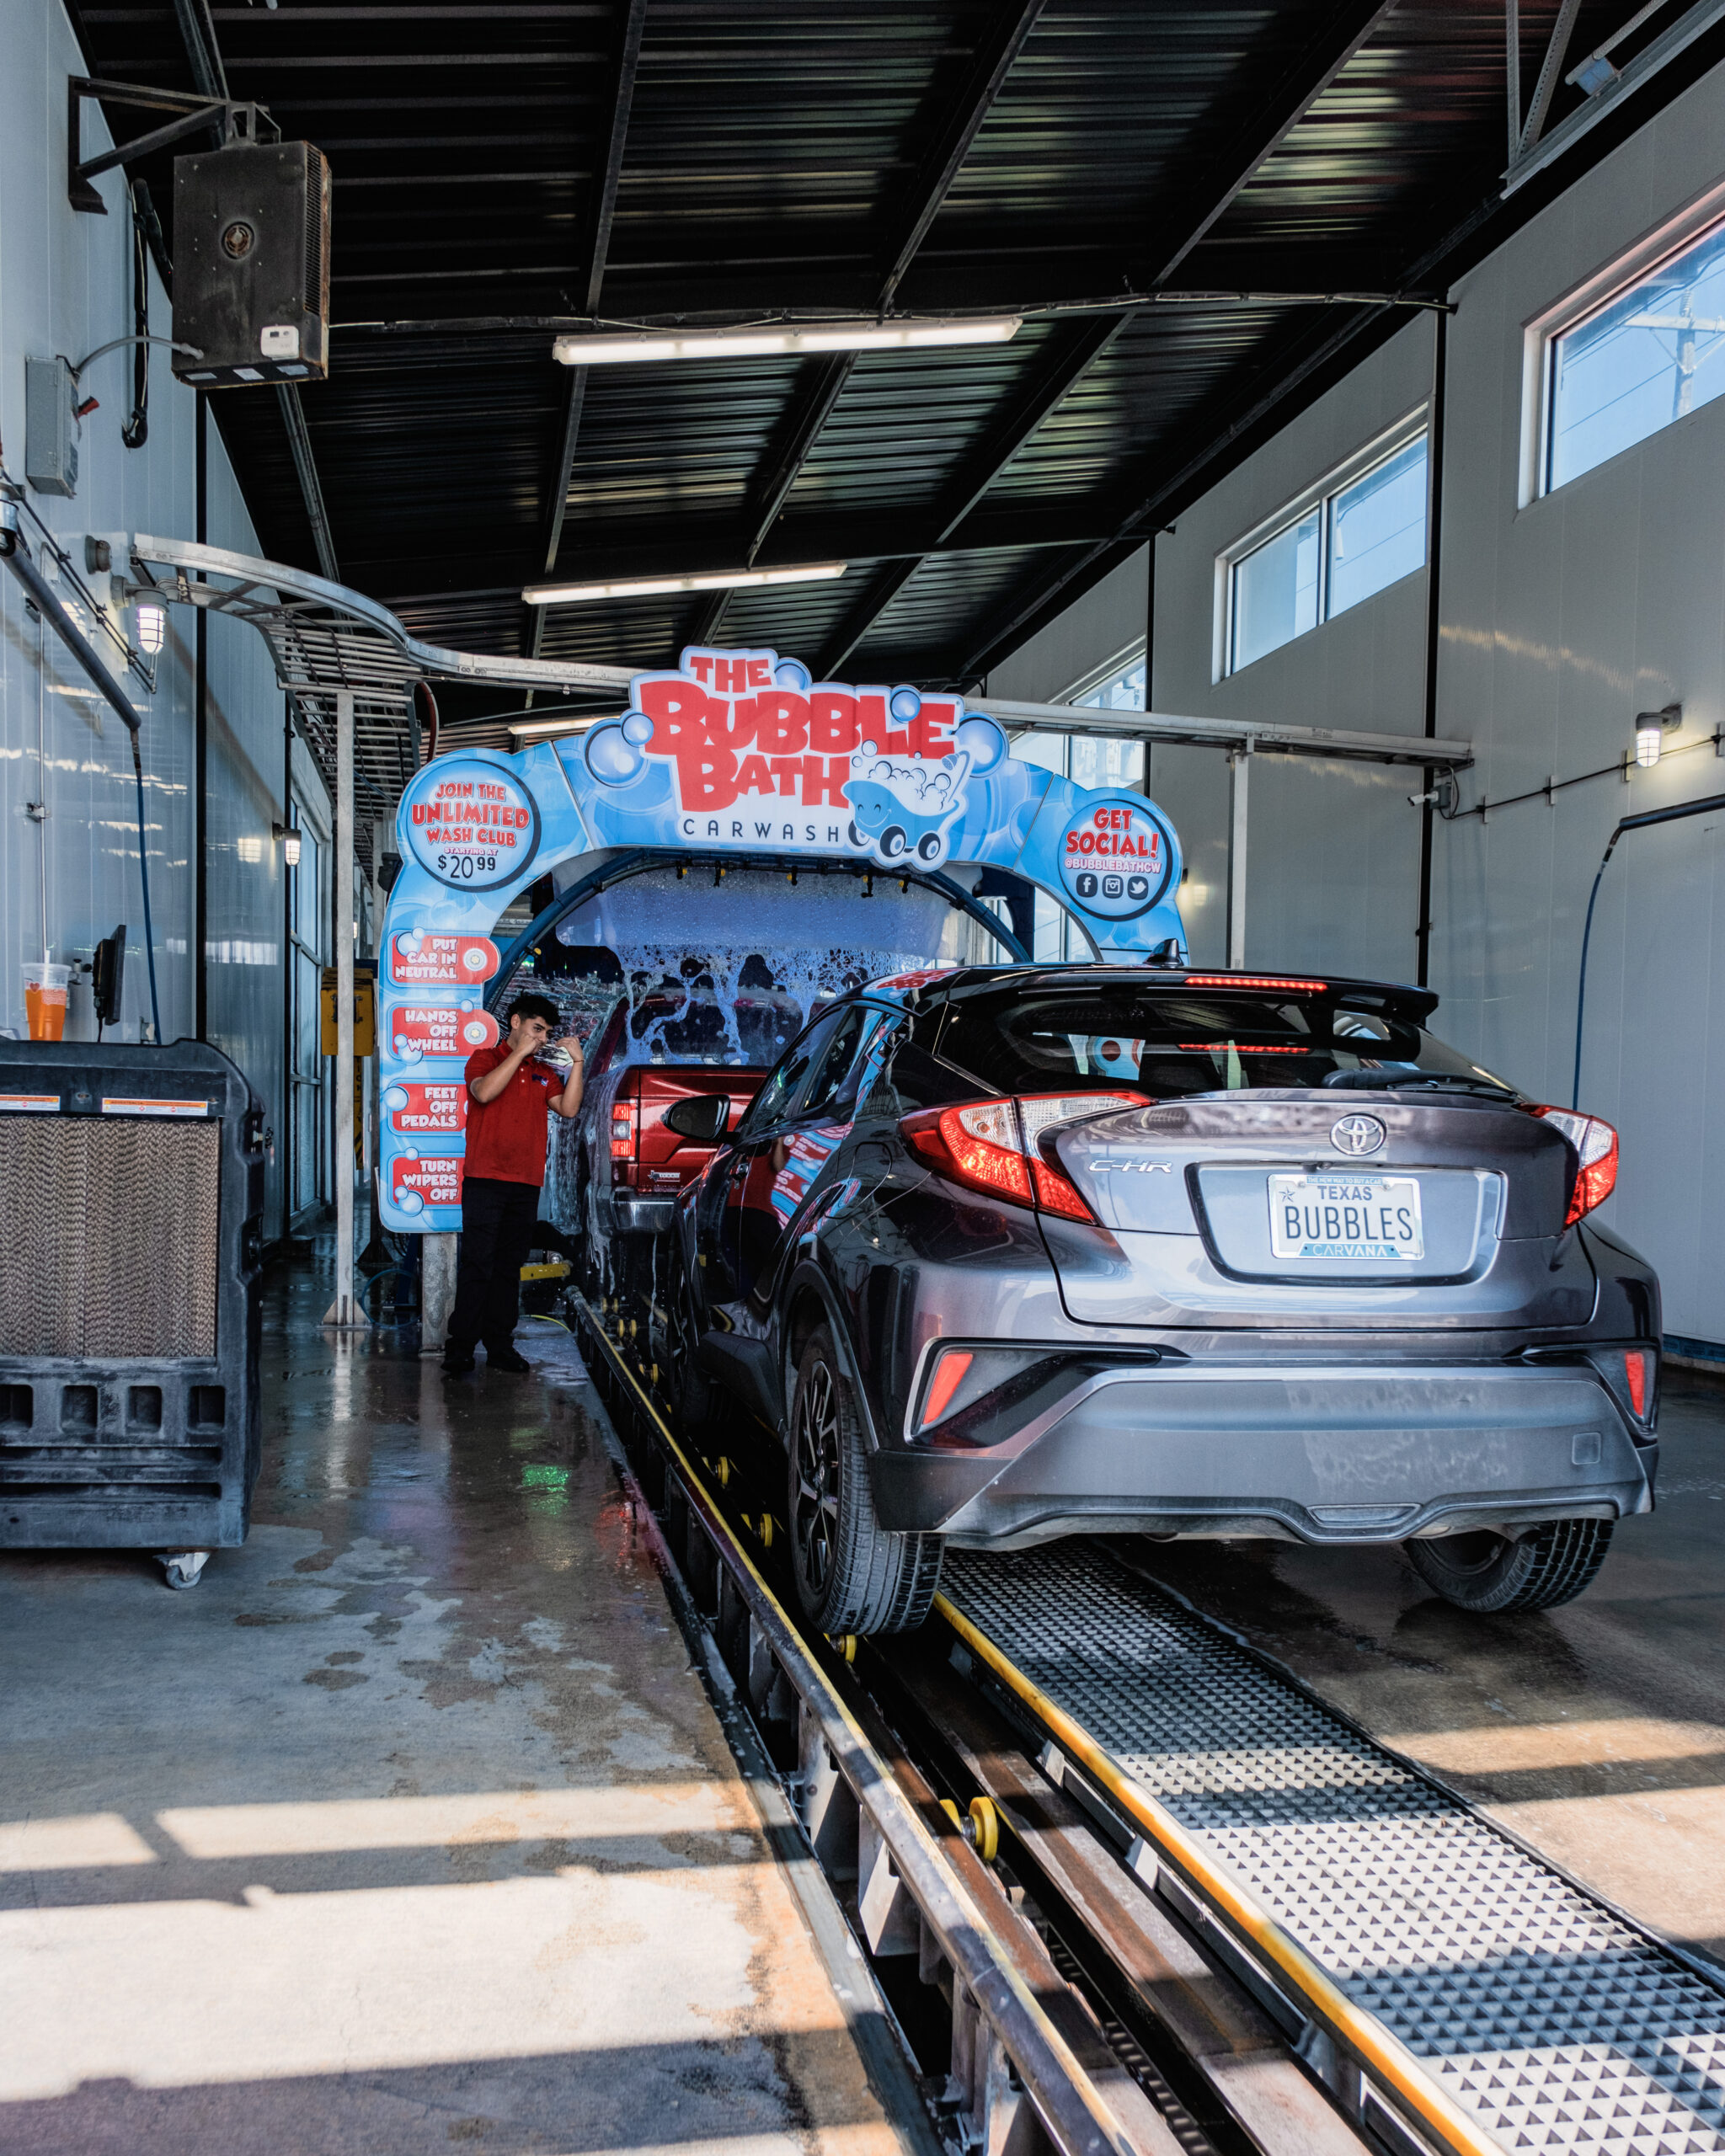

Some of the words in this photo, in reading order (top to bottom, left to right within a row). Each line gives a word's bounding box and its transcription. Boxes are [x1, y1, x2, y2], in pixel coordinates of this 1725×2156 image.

[690, 655, 772, 693] THE
[639, 680, 956, 760] BUBBLE
[676, 744, 851, 813] BATH
[436, 782, 473, 798] JOIN
[478, 784, 505, 800] THE
[411, 802, 530, 830] UNLIMITED
[1093, 808, 1133, 830] GET
[425, 827, 473, 843] WASH
[477, 828, 516, 846] CLUB
[683, 819, 839, 842] CARWASH
[1065, 830, 1159, 858] SOCIAL!
[444, 847, 485, 856] STARTING
[1064, 857, 1162, 873] @BUBBLEBATHCW
[432, 938, 457, 951] PUT
[407, 952, 437, 964] CAR
[441, 953, 457, 965] IN
[395, 966, 457, 979] NEUTRAL
[405, 1010, 457, 1023] HANDS
[430, 1025, 458, 1038] OFF
[408, 1038, 457, 1052] WHEEL
[425, 1086, 457, 1100] FEET
[430, 1100, 457, 1114] OFF
[401, 1114, 457, 1129] PEDALS
[420, 1160, 457, 1173] TURN
[1089, 1160, 1172, 1173] C-HR
[402, 1173, 457, 1187] WIPERS
[430, 1187, 457, 1201] OFF
[1317, 1185, 1372, 1201] TEXAS
[1284, 1206, 1413, 1241] BUBBLES
[1312, 1244, 1387, 1257] CARVANA
